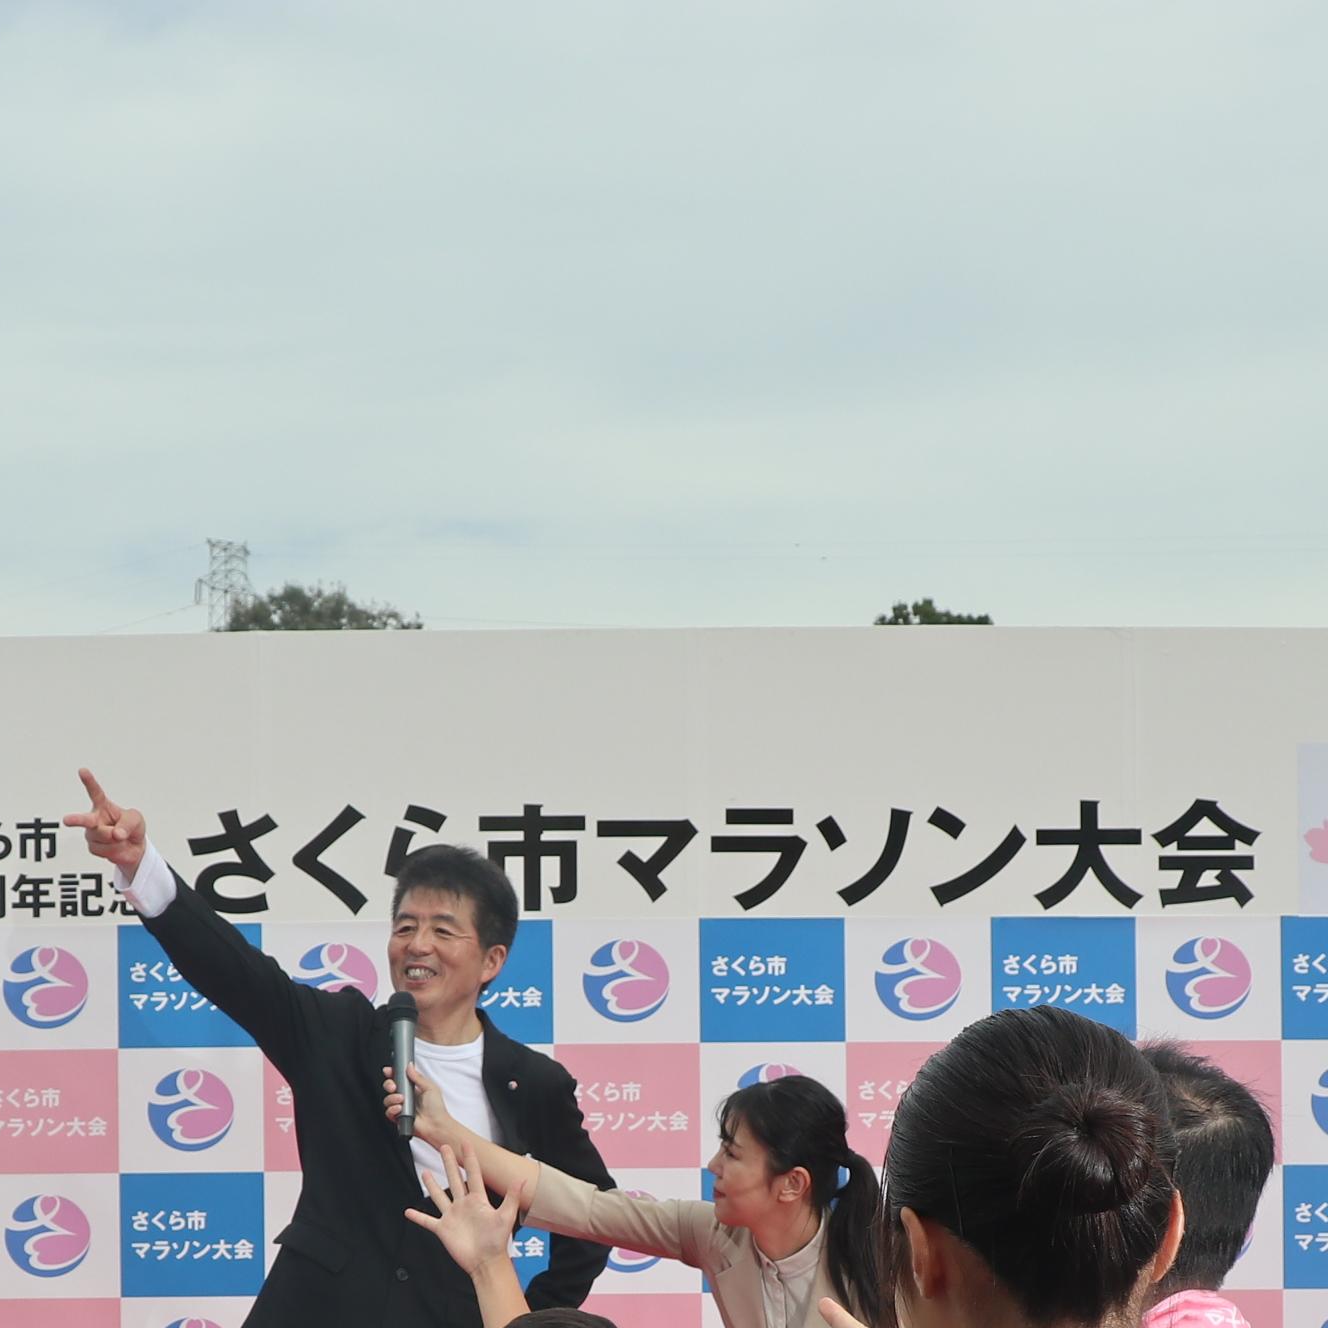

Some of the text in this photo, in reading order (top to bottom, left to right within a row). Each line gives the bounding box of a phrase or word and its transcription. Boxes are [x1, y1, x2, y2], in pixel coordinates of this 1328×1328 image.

[711, 956, 786, 976] さくら市
[1003, 955, 1077, 975] さくら市
[129, 991, 217, 1011] マラソン
[711, 985, 834, 1005] マラソン大会
[1003, 984, 1125, 1004] マラソン大会
[587, 1110, 689, 1131] ラソン大会
[132, 1210, 206, 1231] さくら市
[132, 1239, 254, 1260] マラソン大会
